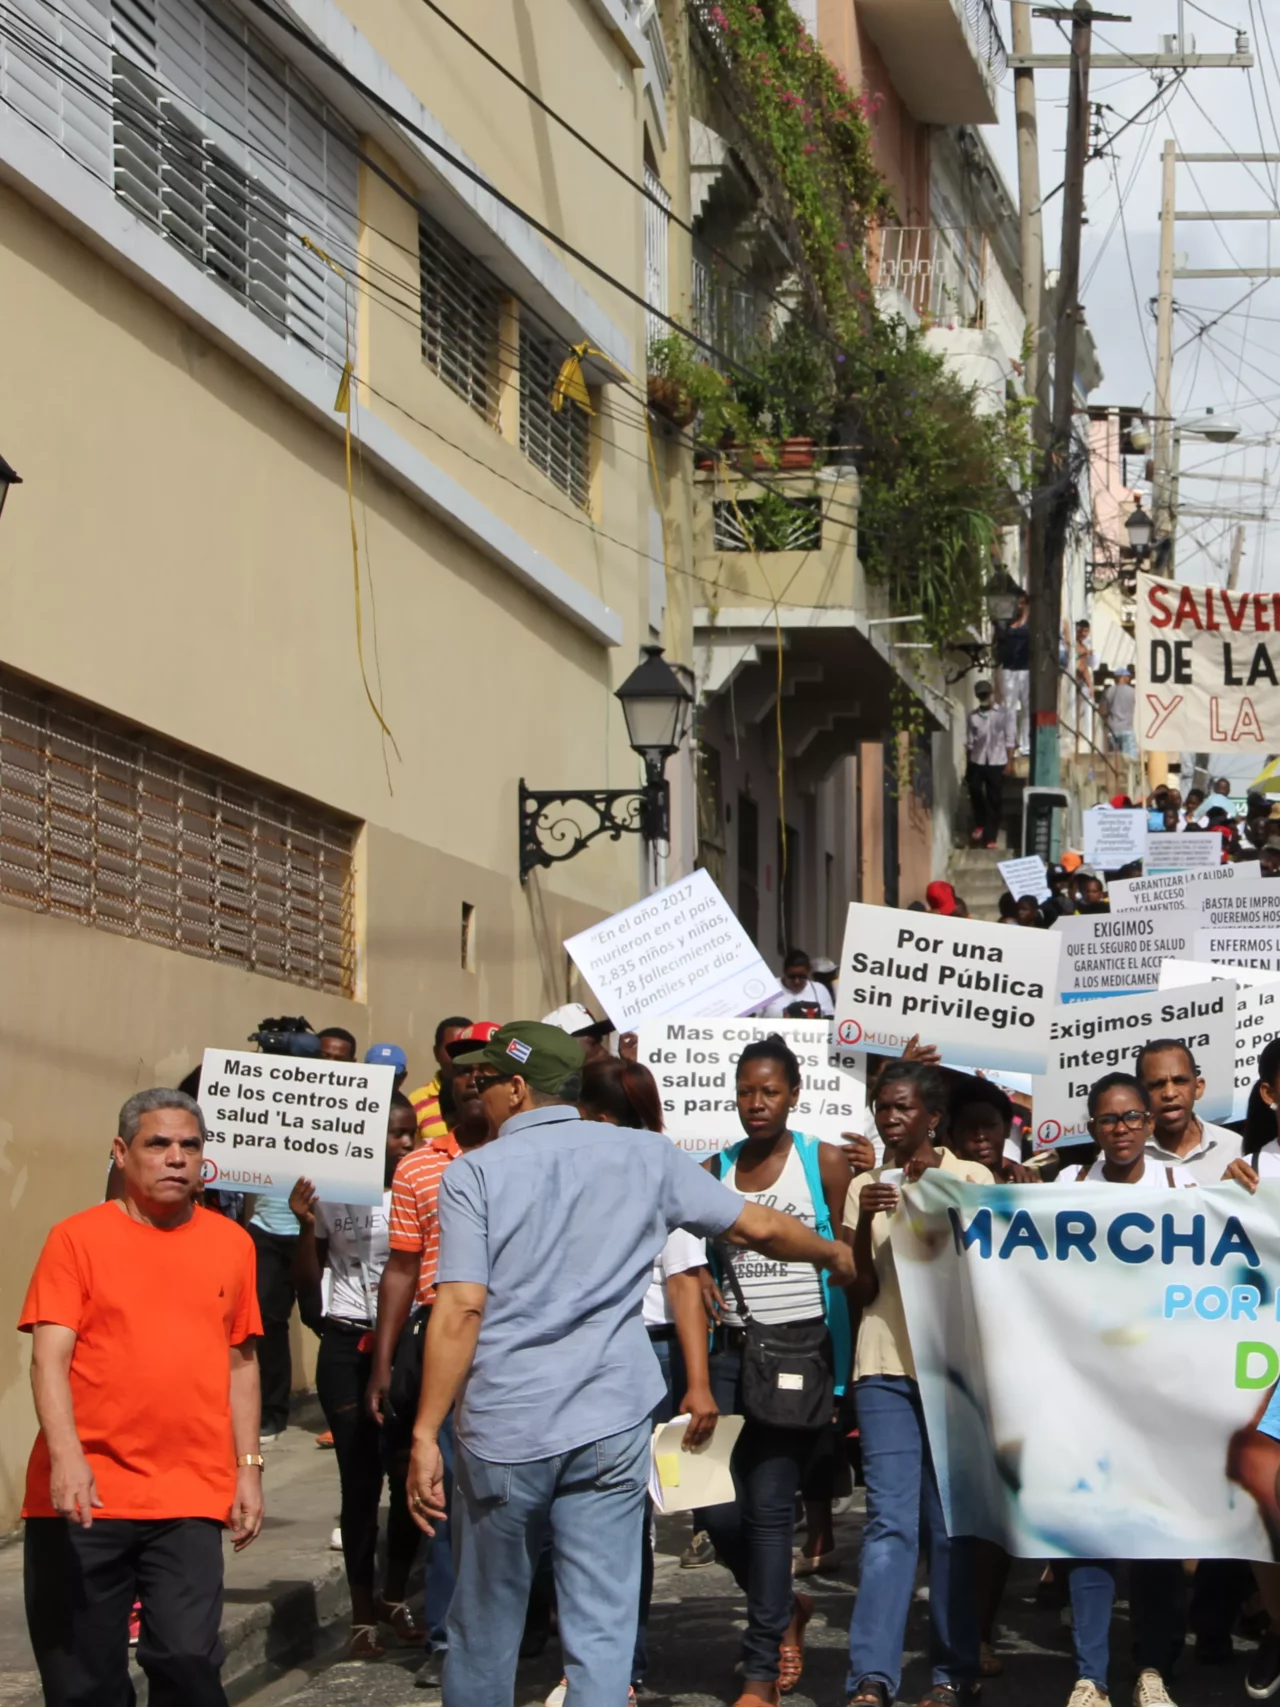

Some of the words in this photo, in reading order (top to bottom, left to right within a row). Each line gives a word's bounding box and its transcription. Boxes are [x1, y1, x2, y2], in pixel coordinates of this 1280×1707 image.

[1150, 639, 1192, 684] DE
[1224, 642, 1279, 686] LA
[1146, 694, 1183, 739] Y
[1210, 696, 1264, 742] LA
[1129, 876, 1184, 892] GARANTIZAR
[1134, 894, 1139, 904] Y
[1142, 893, 1152, 903] EL
[1154, 888, 1184, 901] ACCESO
[618, 920, 631, 934] el
[633, 907, 659, 926] año
[660, 885, 694, 911] 2017
[1236, 897, 1247, 908] DE
[1094, 920, 1154, 938] EXIGIMOS
[1211, 912, 1260, 924] QUEREMOS
[589, 933, 652, 971] murieron
[654, 922, 671, 936] en
[674, 912, 686, 925] el
[690, 896, 717, 919] país
[897, 929, 944, 953] Por
[952, 942, 1004, 963] una
[1067, 944, 1085, 956] QUE
[1088, 943, 1097, 954] EL
[1100, 941, 1136, 954] SEGURO
[1140, 940, 1151, 951] DE
[1154, 938, 1186, 952] SALUD
[1210, 939, 1272, 951] ENFERMOS
[598, 959, 636, 987] 2,835
[639, 938, 675, 967] niños
[677, 935, 685, 947] y
[688, 915, 729, 940] niñas,
[615, 981, 637, 1000] 7.8
[640, 930, 732, 990] fallecimientos
[1075, 958, 1125, 972] GARANTICE
[1128, 958, 1138, 968] EL
[851, 952, 928, 982] Salud
[939, 966, 1043, 999] Pública
[1075, 977, 1080, 988] A
[1083, 976, 1099, 988] LOS
[623, 979, 685, 1017] infantiles
[688, 965, 711, 988] por
[853, 985, 892, 1007] sin
[902, 995, 1035, 1029] privilegio
[1050, 1012, 1153, 1040] Exigimos
[1161, 996, 1224, 1022] Salud
[667, 1025, 714, 1040] Mas
[649, 1049, 677, 1064] de
[686, 1049, 720, 1064] los
[828, 1053, 855, 1069] de
[224, 1059, 263, 1078] Mas
[269, 1067, 368, 1089] cobertura
[662, 1072, 726, 1088] salud
[208, 1082, 231, 1097] de
[238, 1084, 266, 1101] los
[273, 1091, 348, 1110] centros
[355, 1097, 380, 1113] de
[684, 1098, 736, 1115] para
[819, 1098, 852, 1116] /as
[217, 1107, 269, 1125] salud
[311, 1117, 365, 1135] salud
[205, 1130, 226, 1144] es
[233, 1133, 276, 1149] para
[284, 1136, 339, 1155] todos
[345, 1141, 374, 1159] /as
[220, 1169, 274, 1185] MUDHA
[948, 1207, 1260, 1267] MARCHA
[1163, 1283, 1259, 1322] POR
